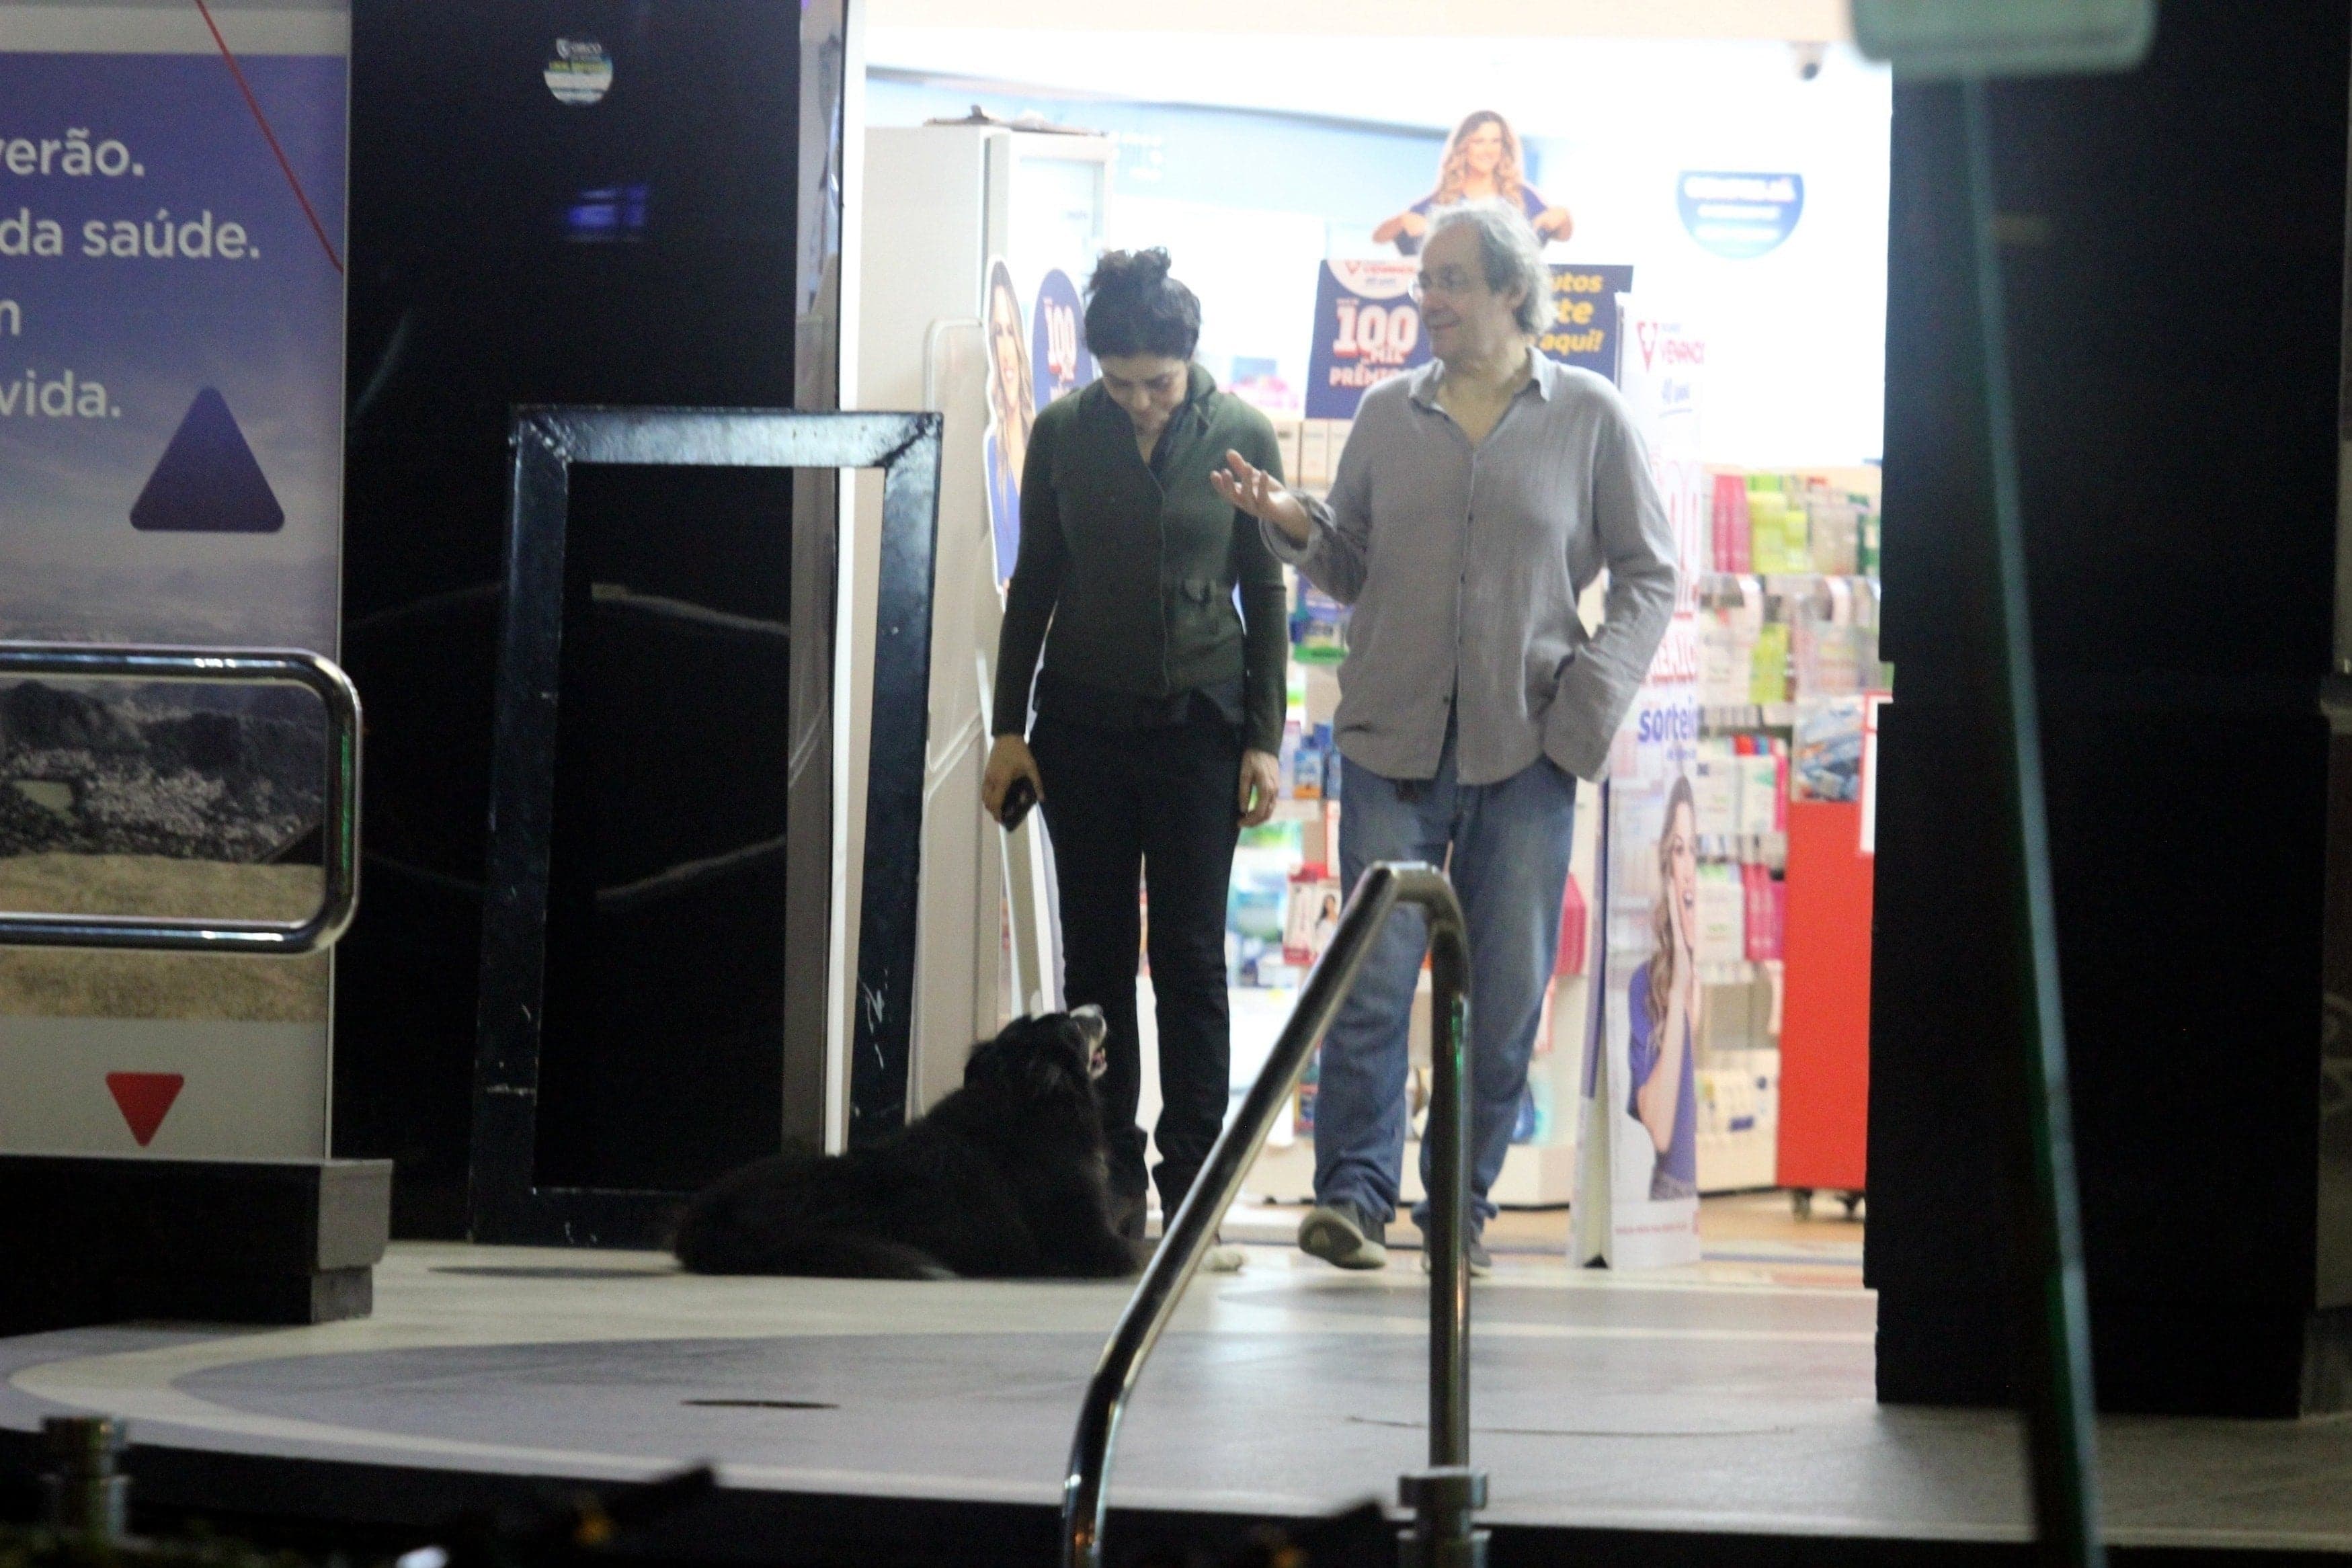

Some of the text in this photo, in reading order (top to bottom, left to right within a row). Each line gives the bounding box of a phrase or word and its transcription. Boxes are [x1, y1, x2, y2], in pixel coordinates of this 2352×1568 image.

[0, 128, 145, 176] erão.
[0, 207, 259, 259] da saúde.
[1333, 305, 1419, 358] 100
[0, 368, 120, 418] vida.
